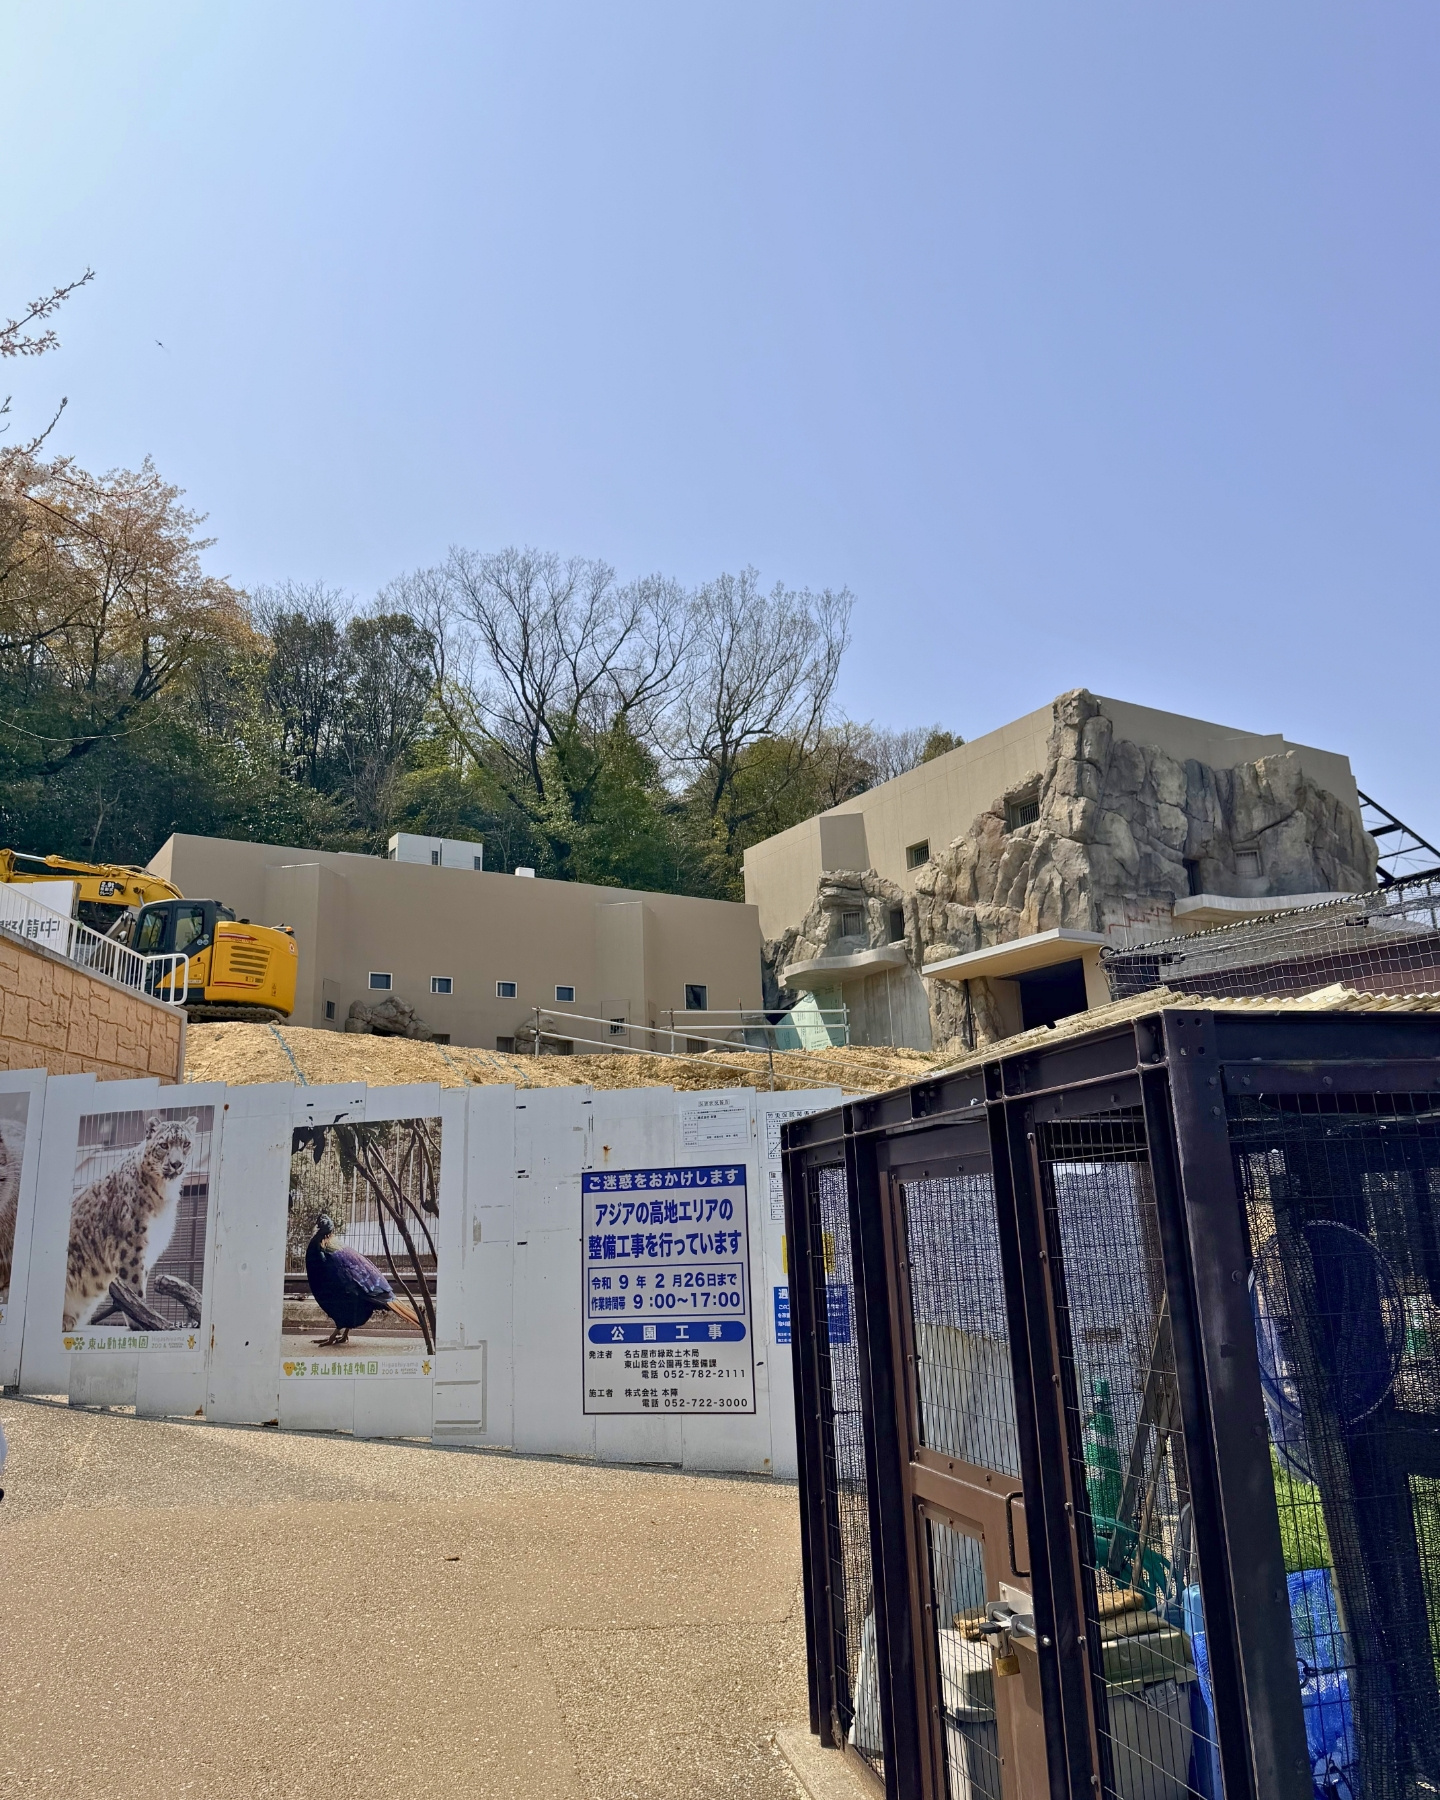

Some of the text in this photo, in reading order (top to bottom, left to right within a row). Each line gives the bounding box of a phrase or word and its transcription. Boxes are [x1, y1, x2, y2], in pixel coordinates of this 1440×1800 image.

[589, 1169, 739, 1190] ご迷惑をおかけします
[595, 1199, 734, 1227] アジアの高地エリアの
[588, 1230, 742, 1260] 整備工事を行っています
[591, 1296, 626, 1311] 作業時間帯
[88, 1335, 149, 1350] 東山動植物園
[589, 1349, 700, 1359] 発注者 名古屋市緑政土木局
[310, 1361, 378, 1376] 東山動植物園
[381, 1361, 418, 1369] Higashiyama
[624, 1359, 718, 1368] 東山総合公園再生整備課
[641, 1369, 745, 1379] 電話 052-782-2111
[589, 1388, 614, 1397] 施工者
[624, 1388, 658, 1398] 株式会社
[642, 1398, 748, 1408] 電話 052-722-3000
